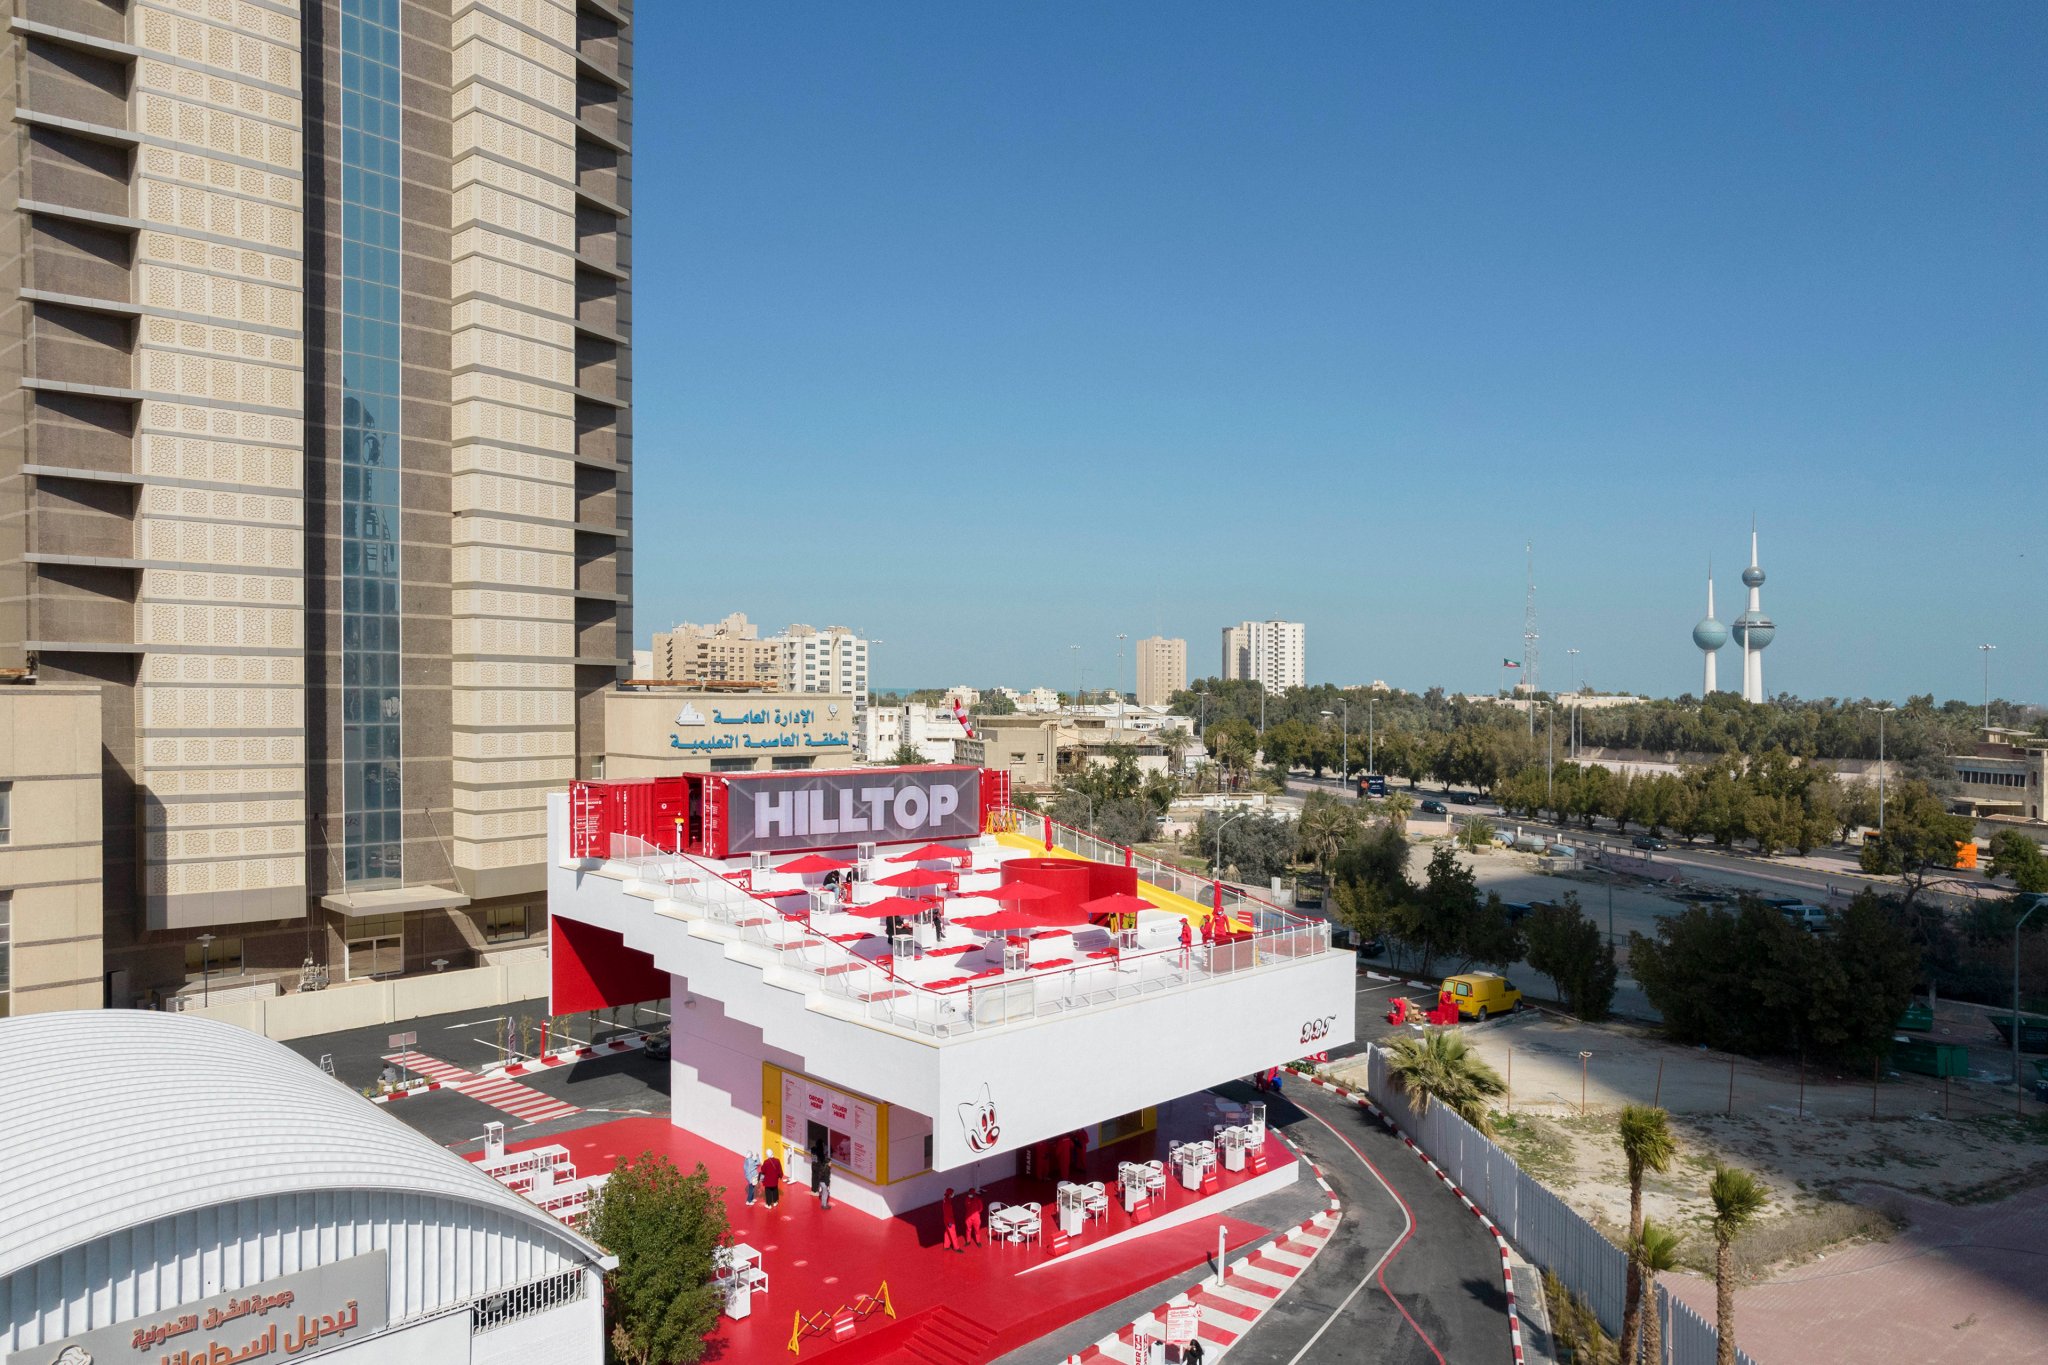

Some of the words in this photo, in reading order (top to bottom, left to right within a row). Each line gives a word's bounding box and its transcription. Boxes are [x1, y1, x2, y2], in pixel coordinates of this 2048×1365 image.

[712, 708, 770, 725] العامة
[774, 708, 815, 728] الإدارة
[669, 734, 739, 754] التعليمية
[742, 732, 800, 749] العاصمة
[755, 784, 959, 839] HILLTOP
[809, 1095, 823, 1104] ORDER
[810, 1101, 822, 1110] HERE
[832, 1104, 847, 1113] ORDER
[833, 1110, 846, 1119] HERE
[251, 1289, 295, 1317] جمعية
[203, 1298, 250, 1330] الشرق
[131, 1314, 199, 1352] التعاونية
[284, 1300, 359, 1355] تبديل
